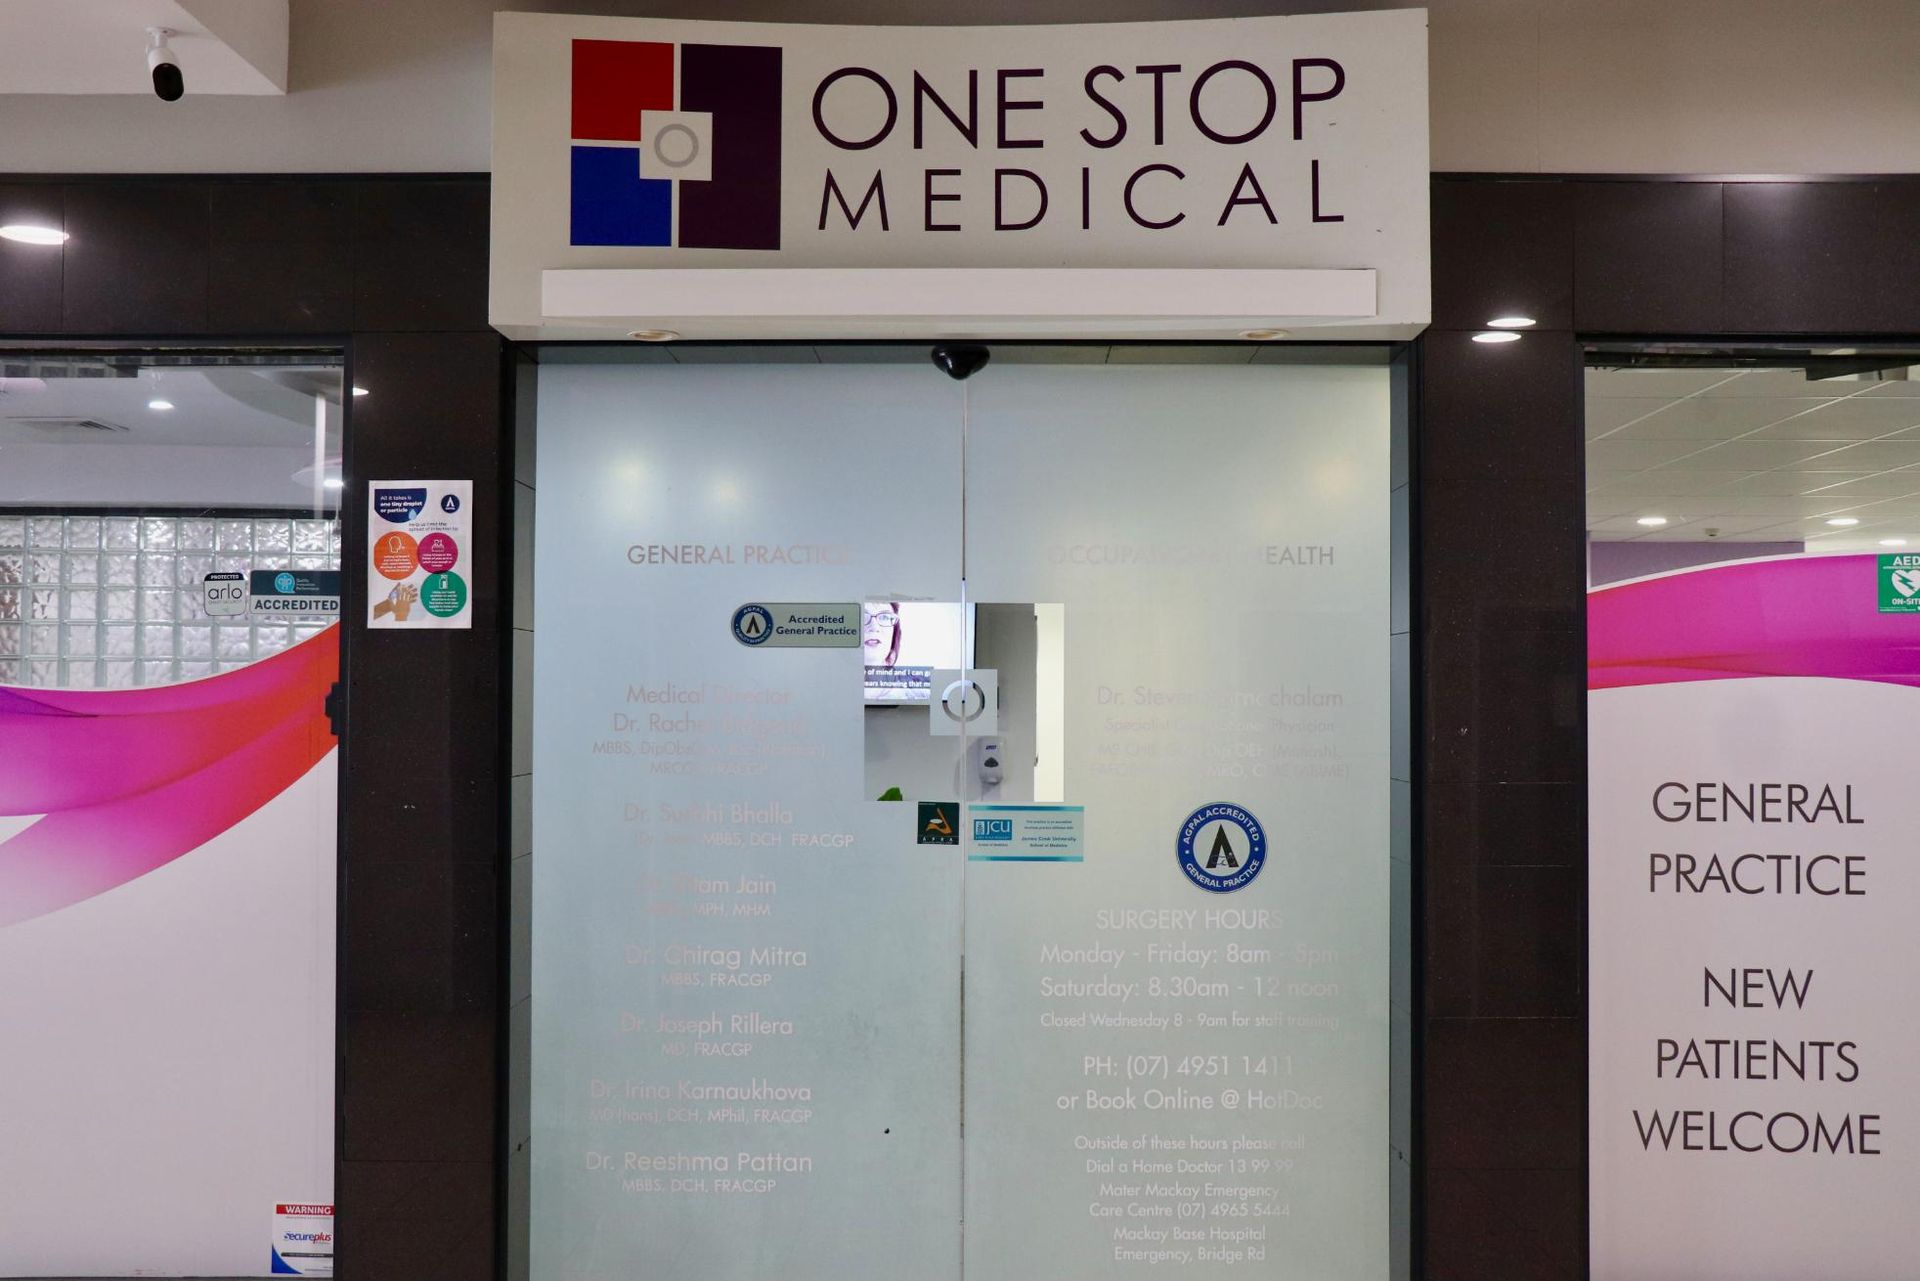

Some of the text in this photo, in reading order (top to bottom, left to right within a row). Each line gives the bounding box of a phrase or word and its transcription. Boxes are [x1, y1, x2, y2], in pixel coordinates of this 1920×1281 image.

[812, 58, 1345, 150] ONE STOP
[819, 160, 1344, 231] MEDICAL
[626, 544, 735, 565] GENERAL
[1893, 556, 1920, 566] AED
[208, 583, 242, 600] arlo
[254, 600, 338, 610] ACCREDITED
[788, 615, 844, 624] Accredited
[776, 626, 856, 635] General Practice
[626, 682, 704, 705] Medical
[1096, 686, 1125, 705] Dr.
[613, 712, 640, 732] Dr.
[1653, 782, 1864, 823] GENERAL
[731, 802, 792, 824] Bhalla
[986, 820, 1010, 835] JCU
[1183, 808, 1259, 844] AGPAL ACCREDITED
[792, 833, 854, 848] FRACGP
[1186, 859, 1259, 888] GENERAL PRACTICE
[1651, 854, 1865, 895] PRACTICE
[736, 874, 776, 894] Jain
[732, 903, 771, 917] MHM
[1096, 910, 1284, 930] SURGERY HOURS
[626, 945, 807, 970] Dr. Chirag Mitra
[1040, 941, 1125, 968] Monday
[1147, 942, 1217, 968] Friday:
[1226, 944, 1271, 963] 8am
[710, 974, 772, 987] FRACGP
[1040, 974, 1139, 1002] Saturday:
[1148, 977, 1229, 998] 8.30am
[1254, 977, 1280, 997] 12
[1287, 982, 1339, 996] noon
[1705, 967, 1813, 1009] NEW
[622, 1012, 793, 1039] Dr. Joseph Rillera
[1040, 1013, 1086, 1027] Closed
[1090, 1012, 1169, 1031] Wednesday
[1174, 1014, 1183, 1027] 8
[1198, 1014, 1228, 1027] 9am
[1231, 1012, 1250, 1027] for
[1254, 1011, 1283, 1027] staff
[694, 1042, 752, 1056] FRACGP
[1084, 1054, 1293, 1080] PH: (07) 4951 1411
[1658, 1039, 1858, 1082] PATIENTS
[626, 1080, 671, 1100] Irina
[678, 1078, 812, 1100] Karnaukhova
[1056, 1087, 1324, 1110] or Book Online @ HotDoc
[708, 1107, 749, 1124] MPhil,
[754, 1108, 812, 1123] FRACGP
[1633, 1110, 1880, 1154] WELCOME
[1074, 1135, 1128, 1150] Outside
[1132, 1135, 1147, 1150] of
[1150, 1135, 1186, 1150] these
[1190, 1135, 1228, 1150] hours
[1232, 1135, 1276, 1153] please
[586, 1150, 812, 1172] Dr. Reeshma Pattan
[1086, 1159, 1294, 1174] Dial a Home Doctor 13 99 99
[622, 1179, 666, 1193] MBBS,
[714, 1178, 776, 1192] FRACGP
[1100, 1182, 1280, 1202] Mater Mackay Emergency
[285, 1206, 332, 1215] WARNING
[1089, 1203, 1290, 1220] Care Centre (07) 4965 5444
[1113, 1226, 1266, 1244] Mackay Base Hospital
[1114, 1246, 1266, 1264] Emergency, Bridge Rd
